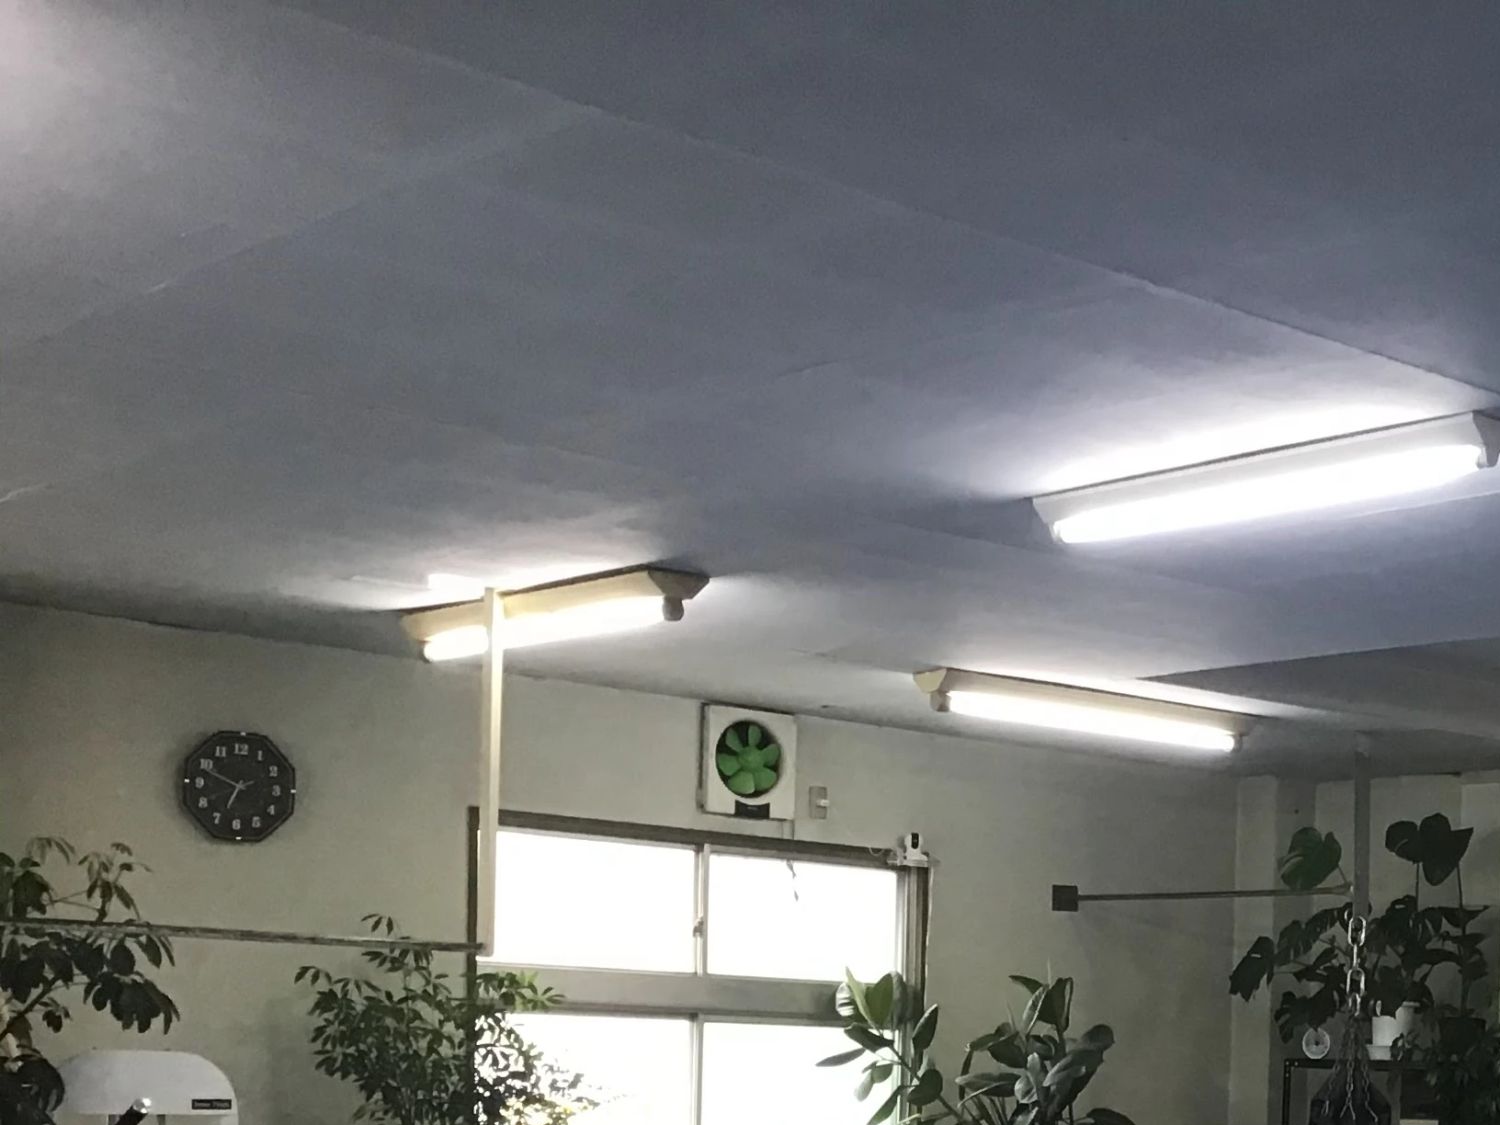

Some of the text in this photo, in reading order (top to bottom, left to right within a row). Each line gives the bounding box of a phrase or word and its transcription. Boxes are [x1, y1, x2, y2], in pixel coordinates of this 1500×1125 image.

[215, 746, 227, 757] 11
[234, 743, 249, 755] 12
[257, 750, 263, 761] 1
[269, 765, 278, 777] 2
[195, 777, 204, 789] 9
[272, 785, 281, 797] 3
[198, 796, 208, 808] 8
[267, 804, 275, 815] 4
[213, 812, 221, 824] 7
[252, 816, 261, 828] 5
[232, 819, 241, 830] 6
